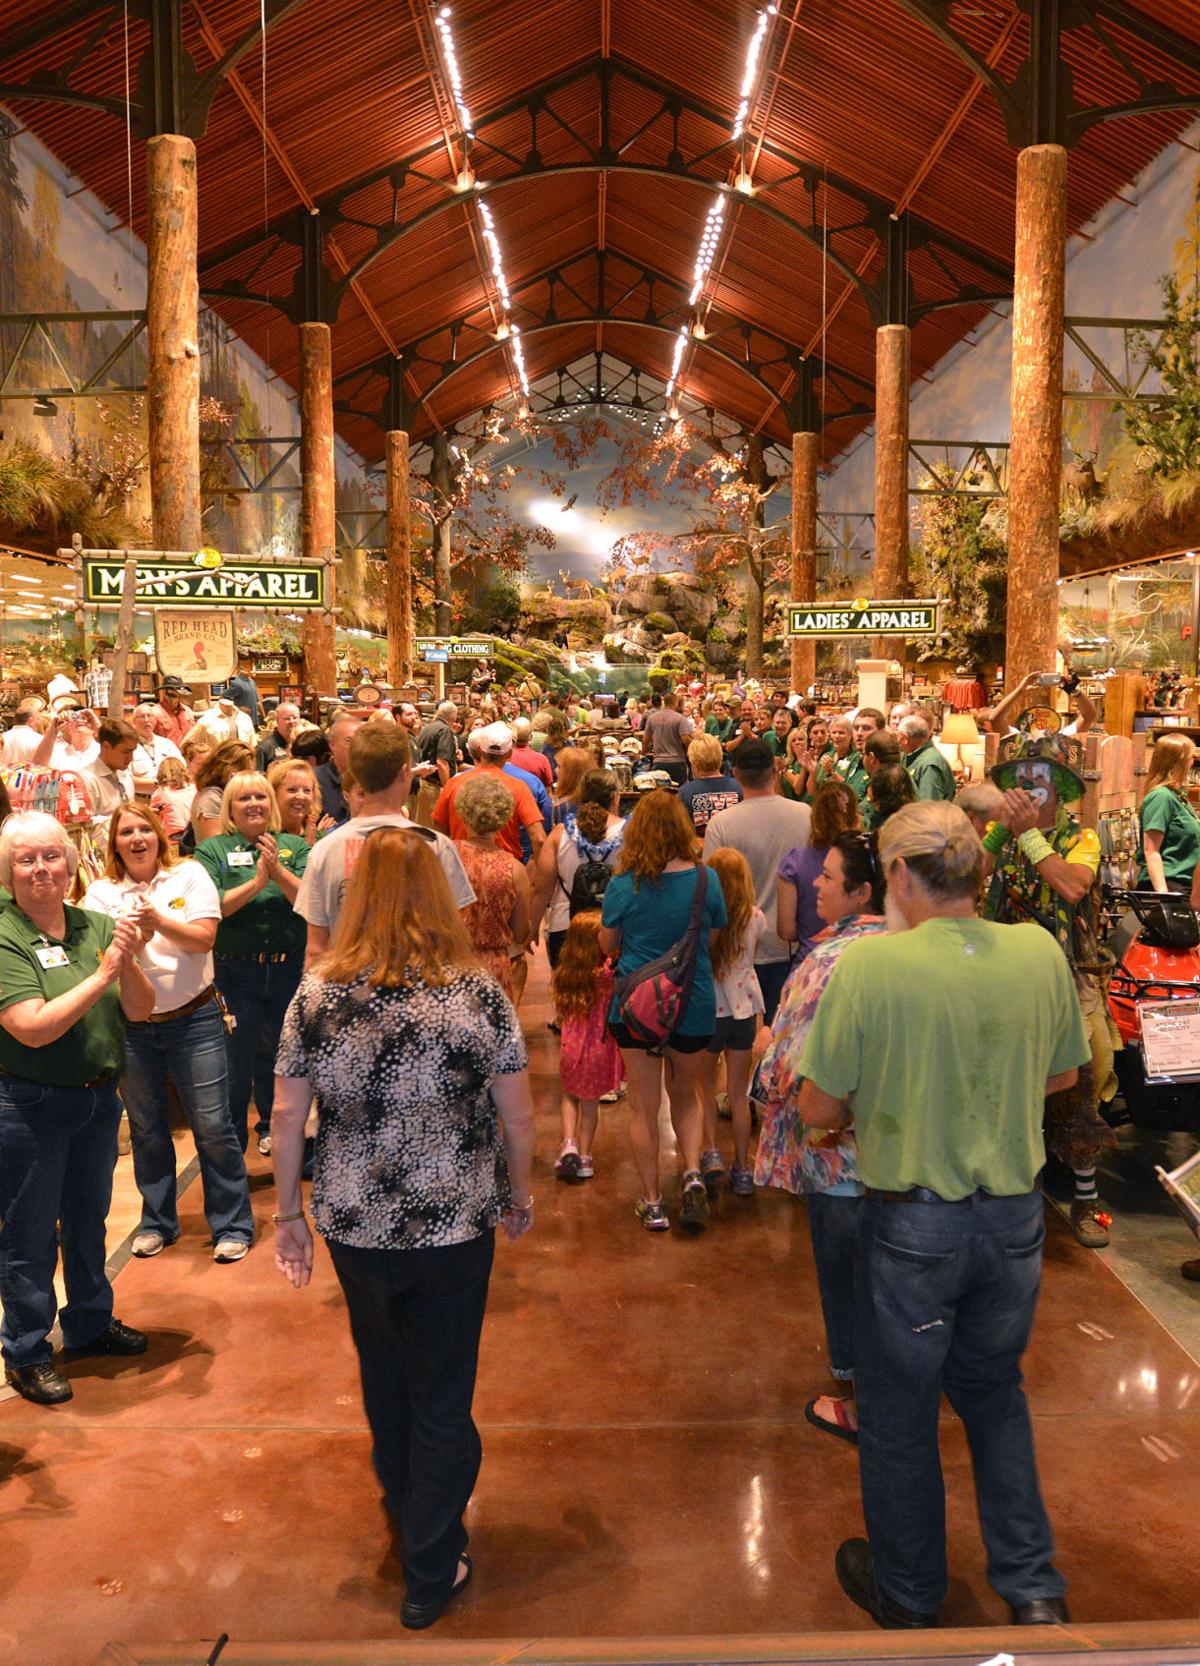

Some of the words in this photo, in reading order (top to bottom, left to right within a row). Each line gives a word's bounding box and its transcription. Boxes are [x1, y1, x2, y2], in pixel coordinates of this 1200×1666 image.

[195, 572, 313, 598] APPAREL
[162, 620, 187, 640] RED
[193, 620, 227, 639] HEAD
[794, 613, 854, 630] LADIES'
[857, 611, 929, 629] APPAREL
[453, 644, 489, 653] CLOTHING
